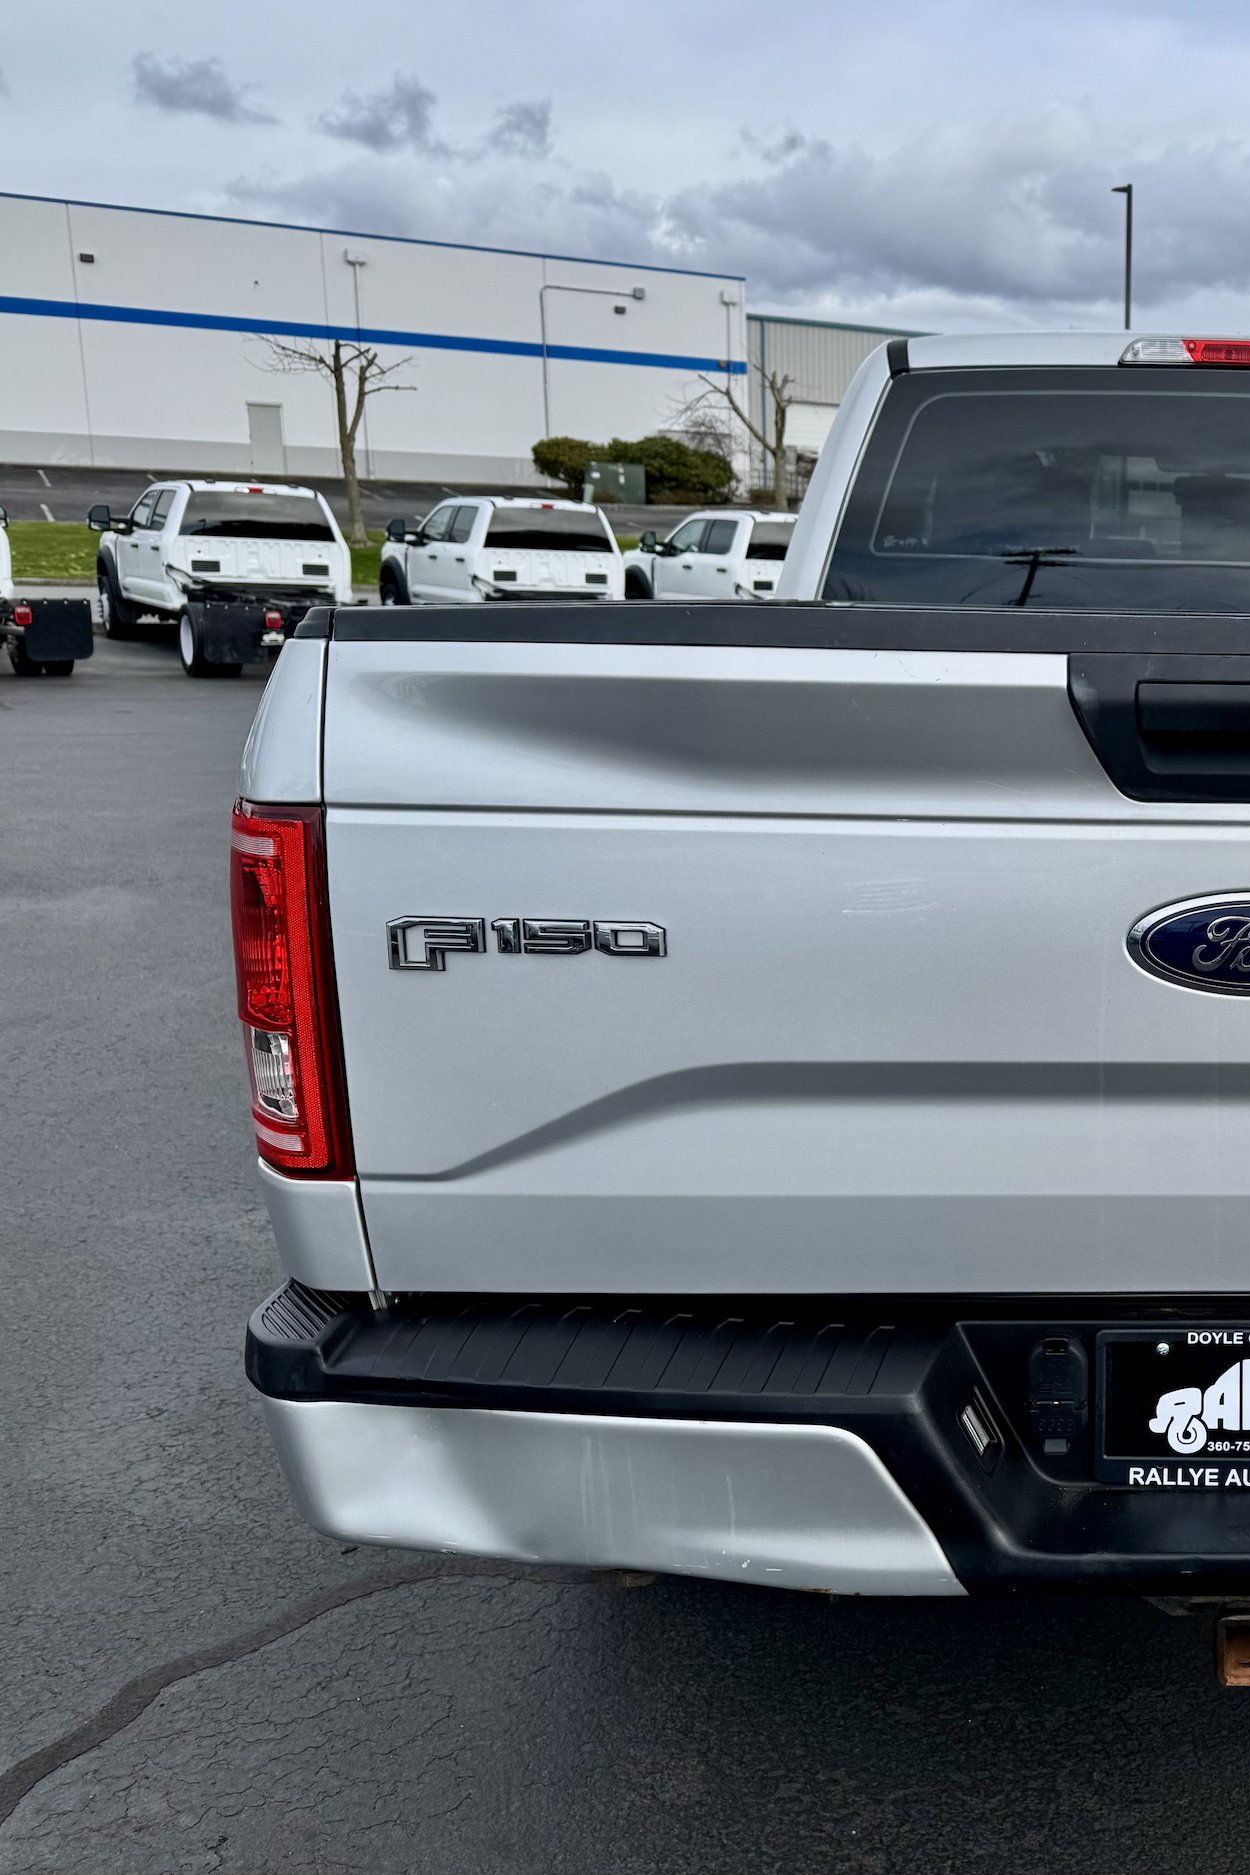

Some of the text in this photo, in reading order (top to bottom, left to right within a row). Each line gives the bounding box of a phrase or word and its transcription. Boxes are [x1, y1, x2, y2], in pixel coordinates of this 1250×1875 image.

[386, 915, 668, 971] F150
[1187, 1332, 1244, 1345] DOYLE
[1128, 1467, 1219, 1487] RALLYE
